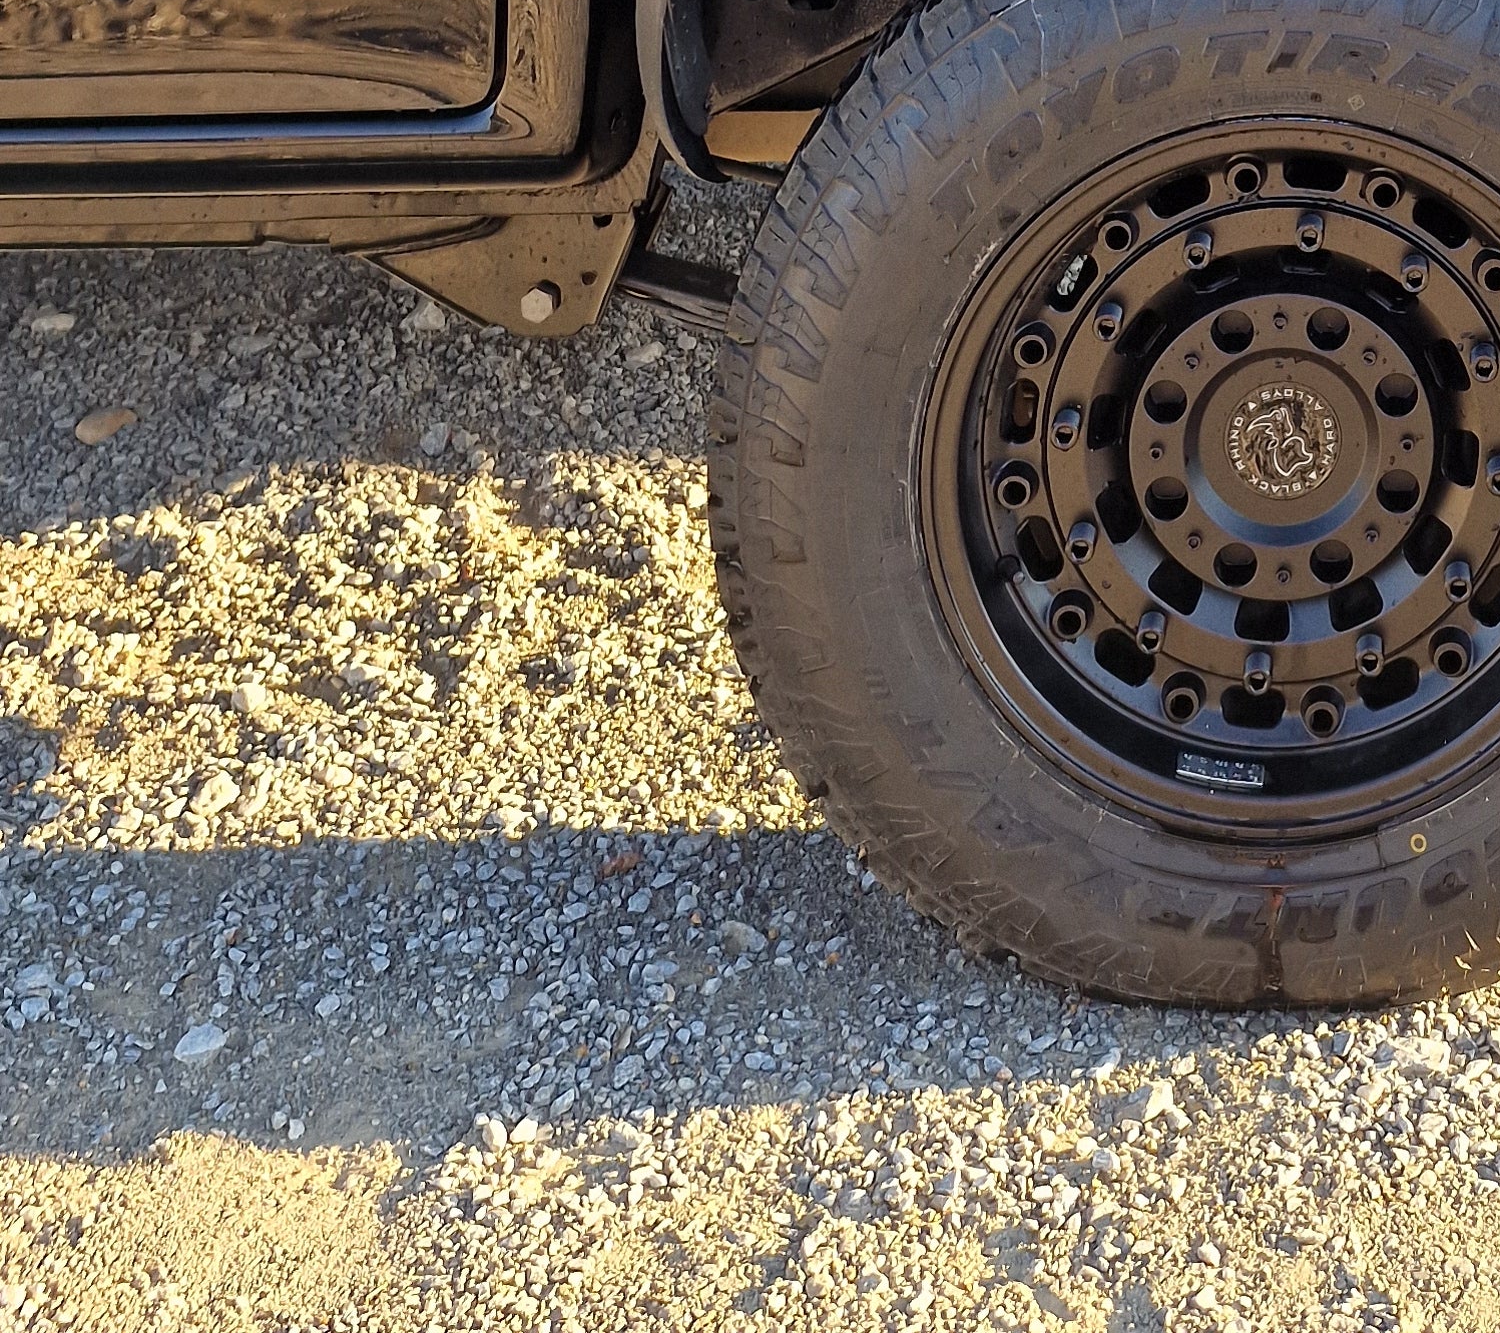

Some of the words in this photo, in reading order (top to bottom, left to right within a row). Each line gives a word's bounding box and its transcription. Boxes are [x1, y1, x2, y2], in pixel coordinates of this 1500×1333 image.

[927, 43, 1183, 235] TOYO
[1261, 388, 1324, 411] ALLOYS
[1230, 416, 1246, 471] RHINO
[1322, 418, 1335, 465] HARD
[1248, 474, 1302, 493] BLACK
